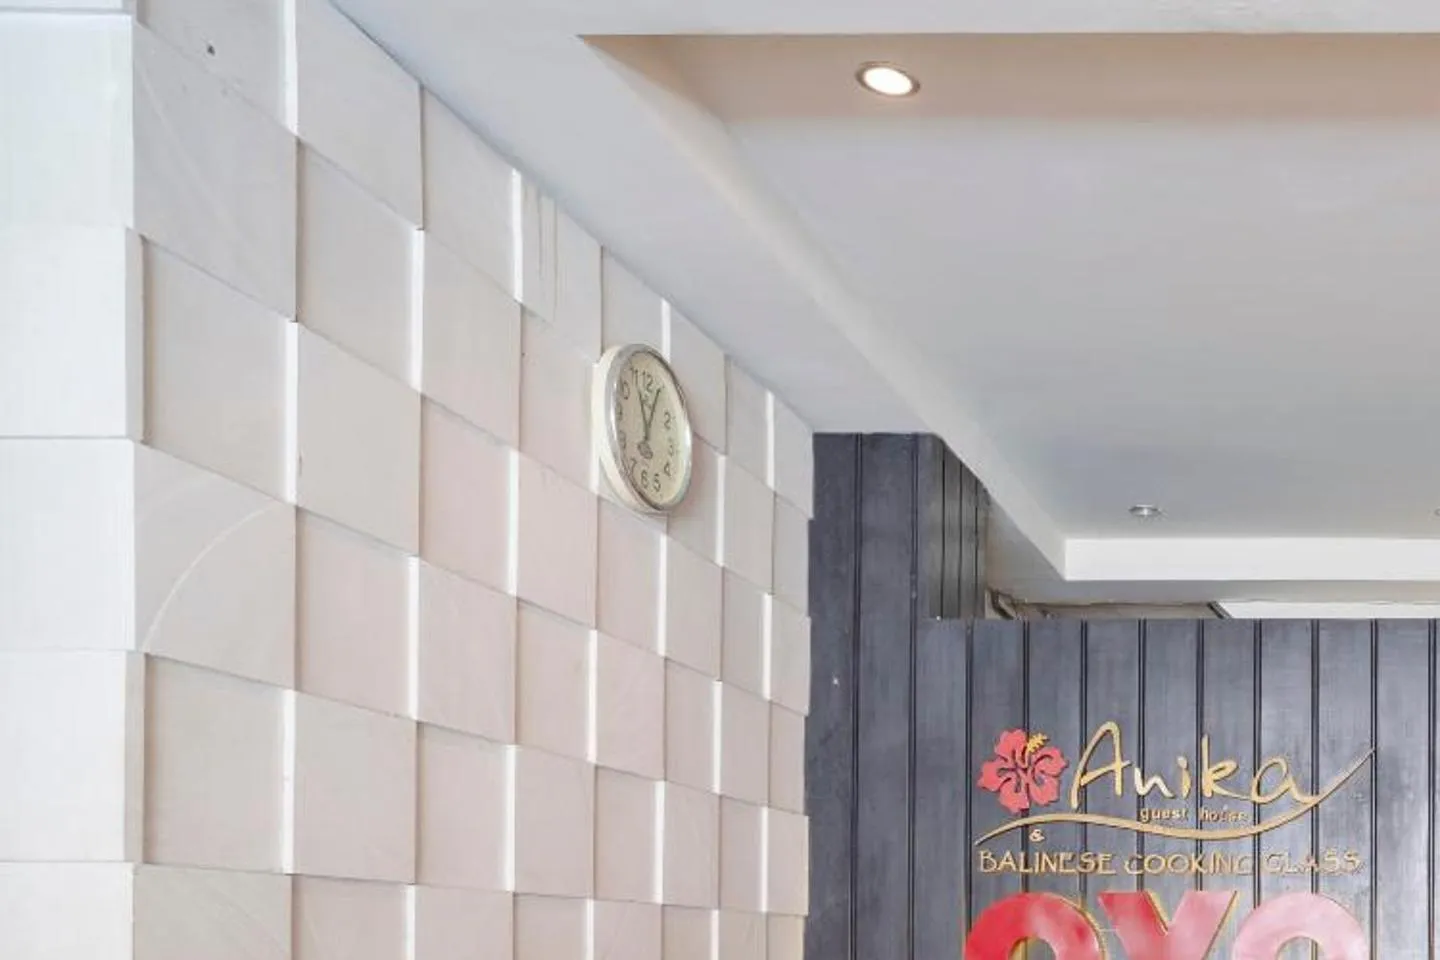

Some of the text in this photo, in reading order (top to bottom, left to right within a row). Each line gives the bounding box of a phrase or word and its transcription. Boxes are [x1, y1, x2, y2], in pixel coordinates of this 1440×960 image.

[1070, 721, 1374, 810] Anika
[1139, 808, 1188, 823] guest
[1029, 828, 1046, 844] &
[978, 848, 1116, 876] BALINESE
